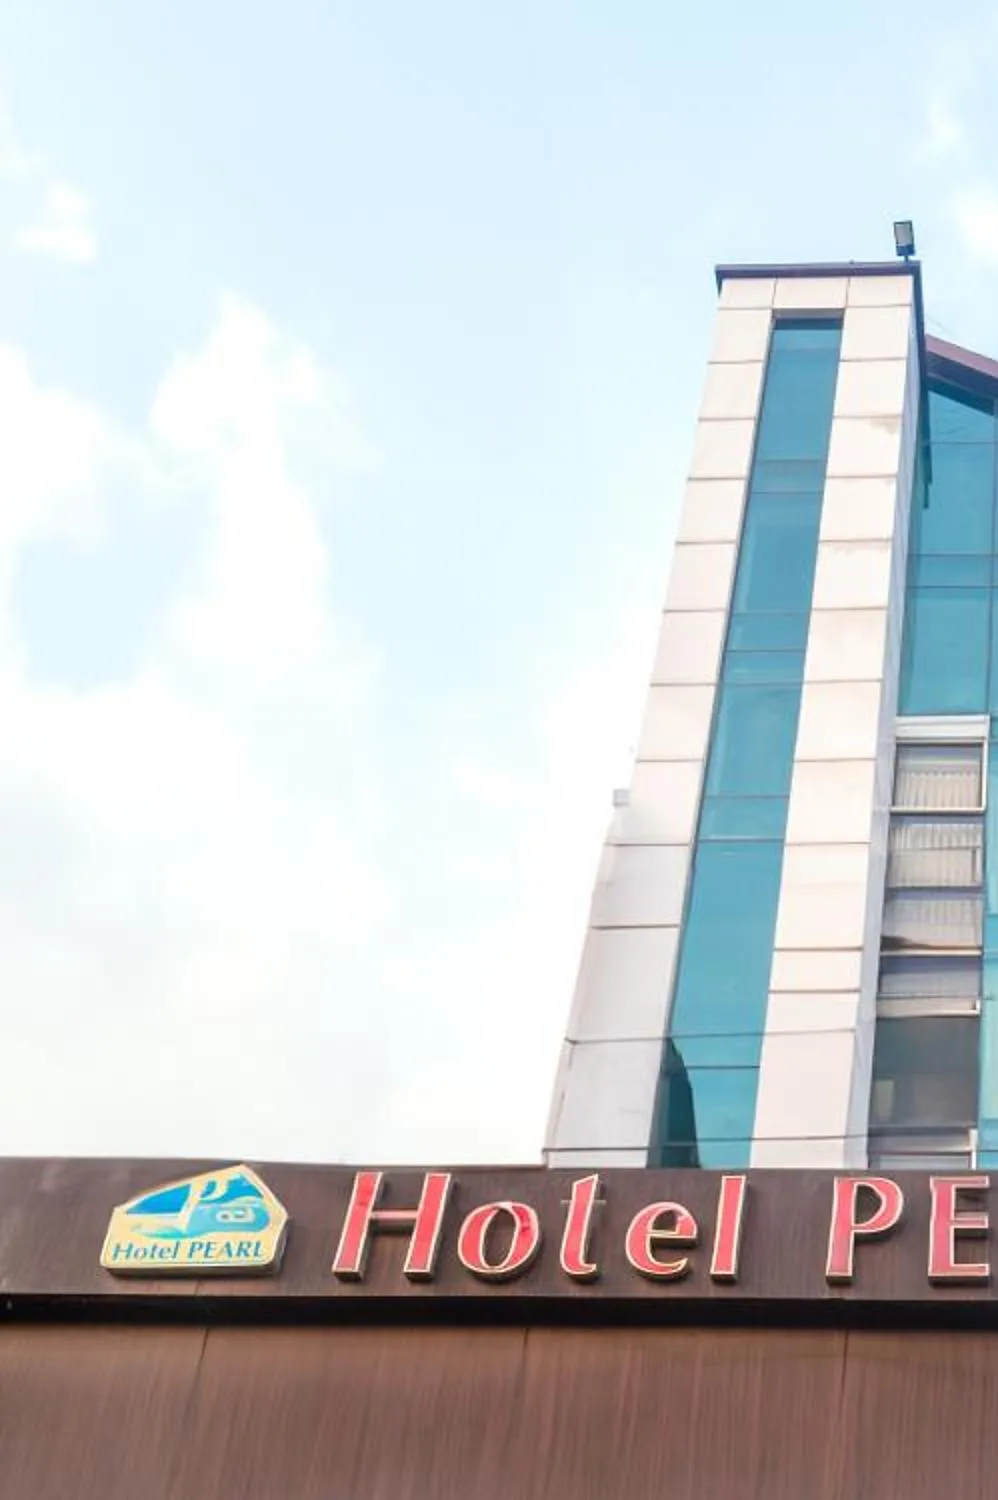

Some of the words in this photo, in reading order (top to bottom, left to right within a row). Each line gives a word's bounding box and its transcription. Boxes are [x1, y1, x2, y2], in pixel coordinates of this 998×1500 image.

[112, 1238, 180, 1260] Hotel
[187, 1239, 265, 1260] PEARL
[332, 1170, 748, 1280] Hotel
